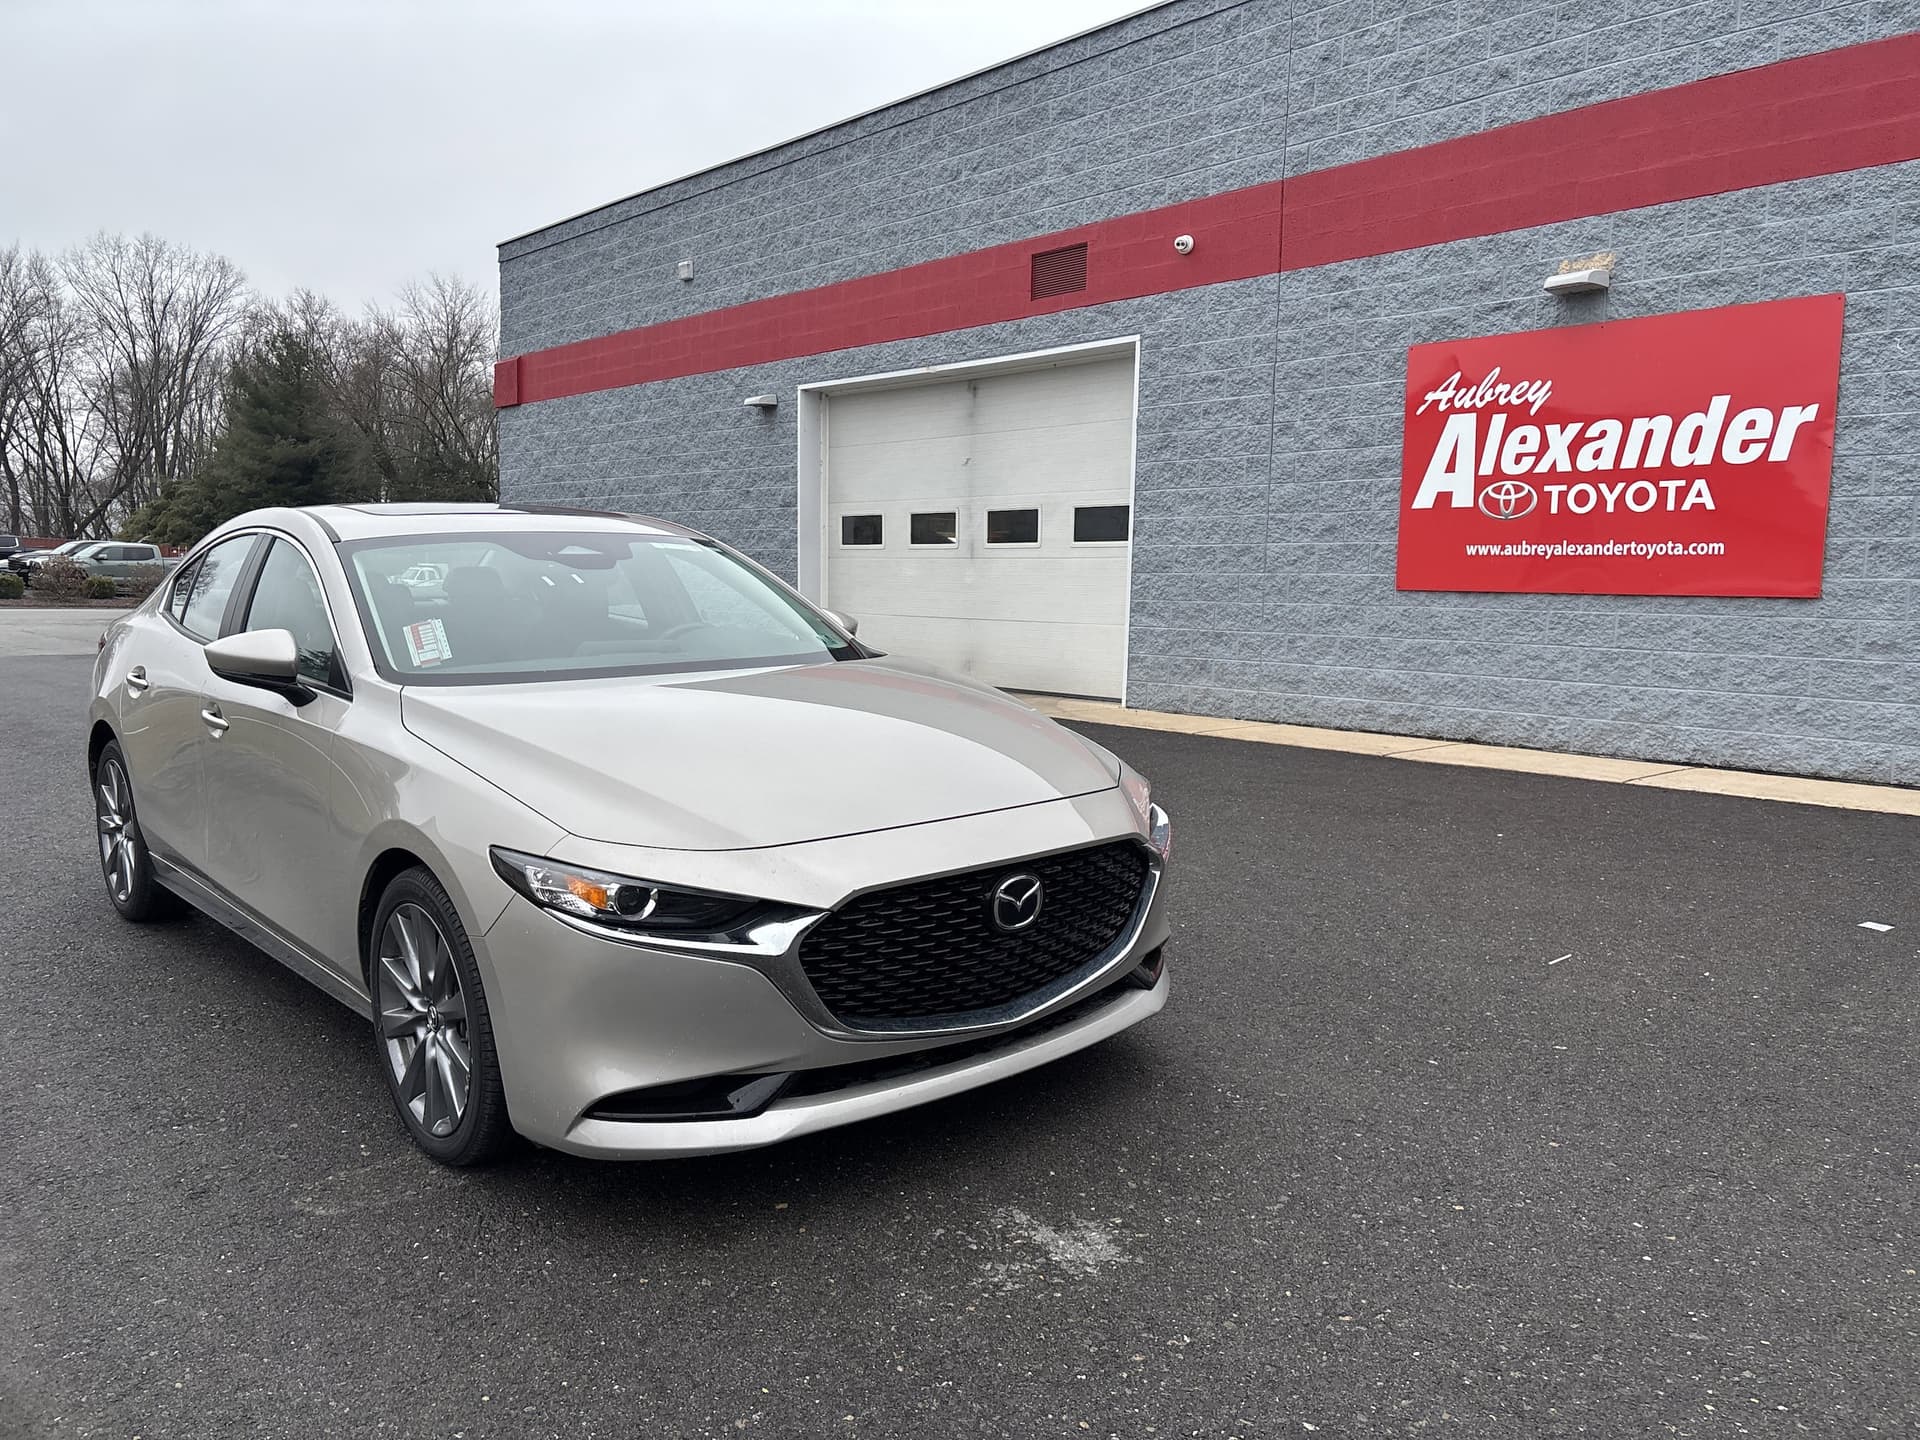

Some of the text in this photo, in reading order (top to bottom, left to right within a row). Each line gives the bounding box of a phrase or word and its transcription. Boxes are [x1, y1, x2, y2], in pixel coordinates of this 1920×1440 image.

[1416, 367, 1553, 416] Aubrey
[1411, 394, 1820, 510] Alexander
[1543, 480, 1716, 515] TOYOTA
[1466, 539, 1725, 561] www.aubreyalexandertoyota.com
